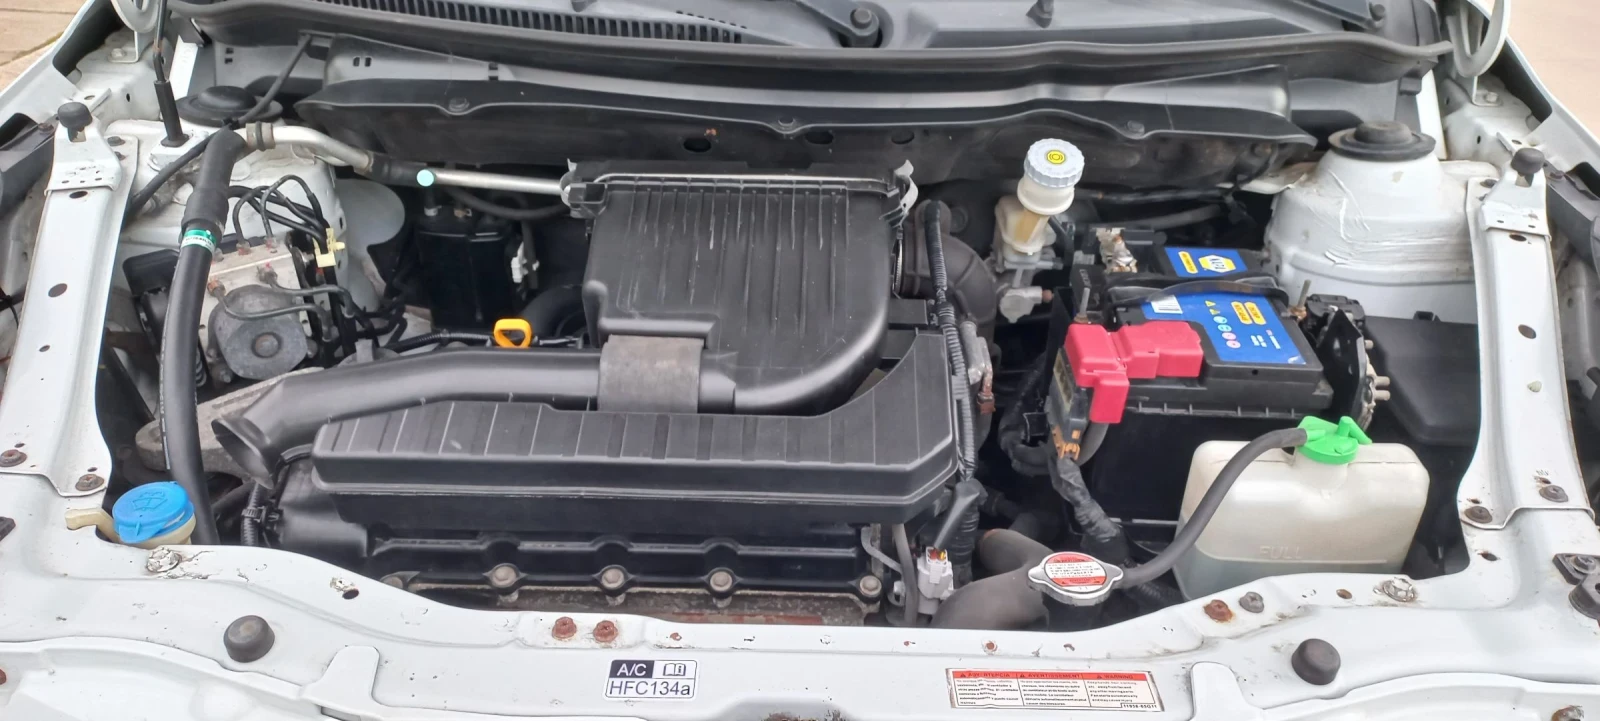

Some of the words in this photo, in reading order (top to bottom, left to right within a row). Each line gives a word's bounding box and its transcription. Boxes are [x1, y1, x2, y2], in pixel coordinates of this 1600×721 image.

[1260, 545, 1302, 559] FULL
[616, 663, 647, 676] A/C
[609, 681, 690, 695] HFC134a
